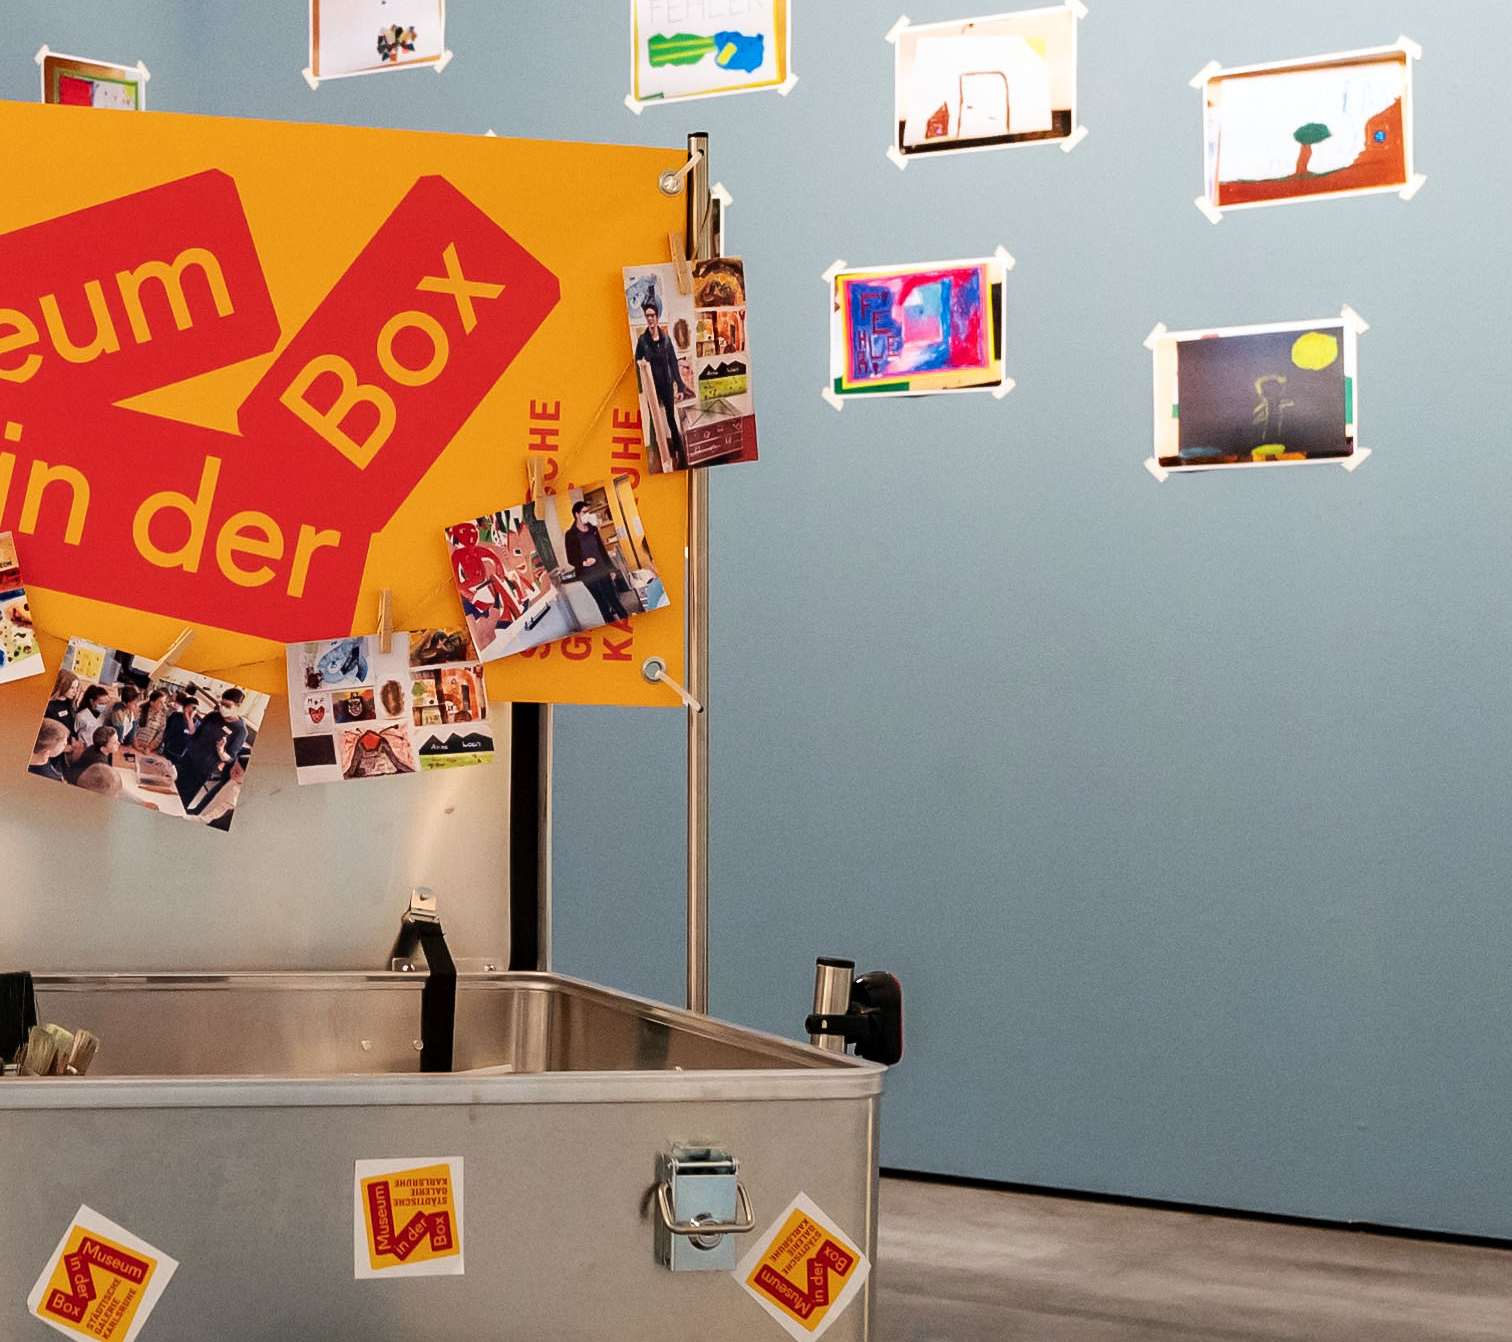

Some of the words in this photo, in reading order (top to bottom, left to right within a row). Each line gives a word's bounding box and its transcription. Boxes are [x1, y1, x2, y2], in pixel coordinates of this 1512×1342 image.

[279, 241, 506, 471] Box
[132, 455, 342, 598] der
[375, 1185, 391, 1251] Museum
[433, 1216, 447, 1247] Box
[393, 1240, 409, 1255] in
[407, 1218, 427, 1241] der
[69, 1255, 82, 1271] in
[82, 1241, 142, 1279] Museum
[810, 1261, 824, 1286] der
[823, 1246, 848, 1271] Box
[74, 1274, 89, 1299] der
[760, 1269, 812, 1316] Museum
[812, 1289, 825, 1303] in
[52, 1293, 81, 1317] Box
